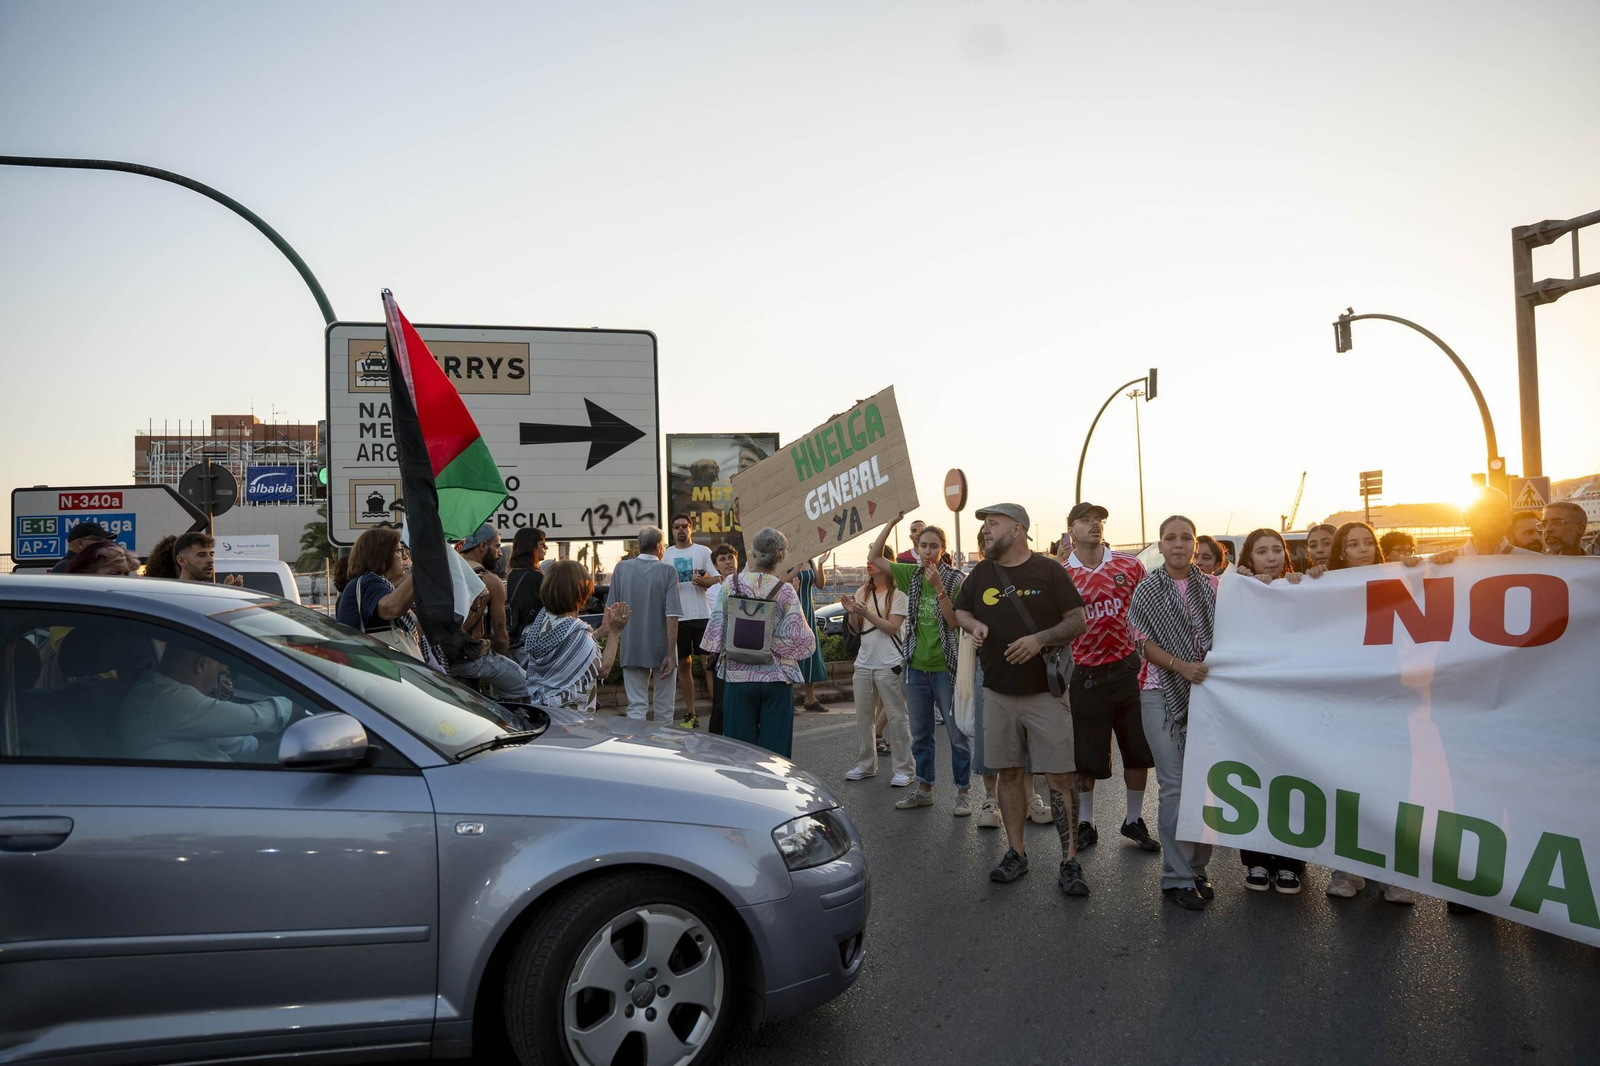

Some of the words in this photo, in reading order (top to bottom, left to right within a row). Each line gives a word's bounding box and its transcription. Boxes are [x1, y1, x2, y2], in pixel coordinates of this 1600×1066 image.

[434, 356, 525, 380] RRYS
[359, 402, 392, 418] NA
[359, 422, 393, 439] ME
[790, 402, 886, 483] HUELGA
[356, 443, 399, 462] ARG
[249, 483, 293, 494] albaida
[804, 455, 890, 521] GENERAL
[61, 494, 120, 508] N-340a
[22, 520, 55, 533] E-15
[487, 512, 563, 529] RCIAL
[833, 506, 863, 541] YA
[21, 541, 57, 553] AP-7
[1363, 573, 1570, 648] NO
